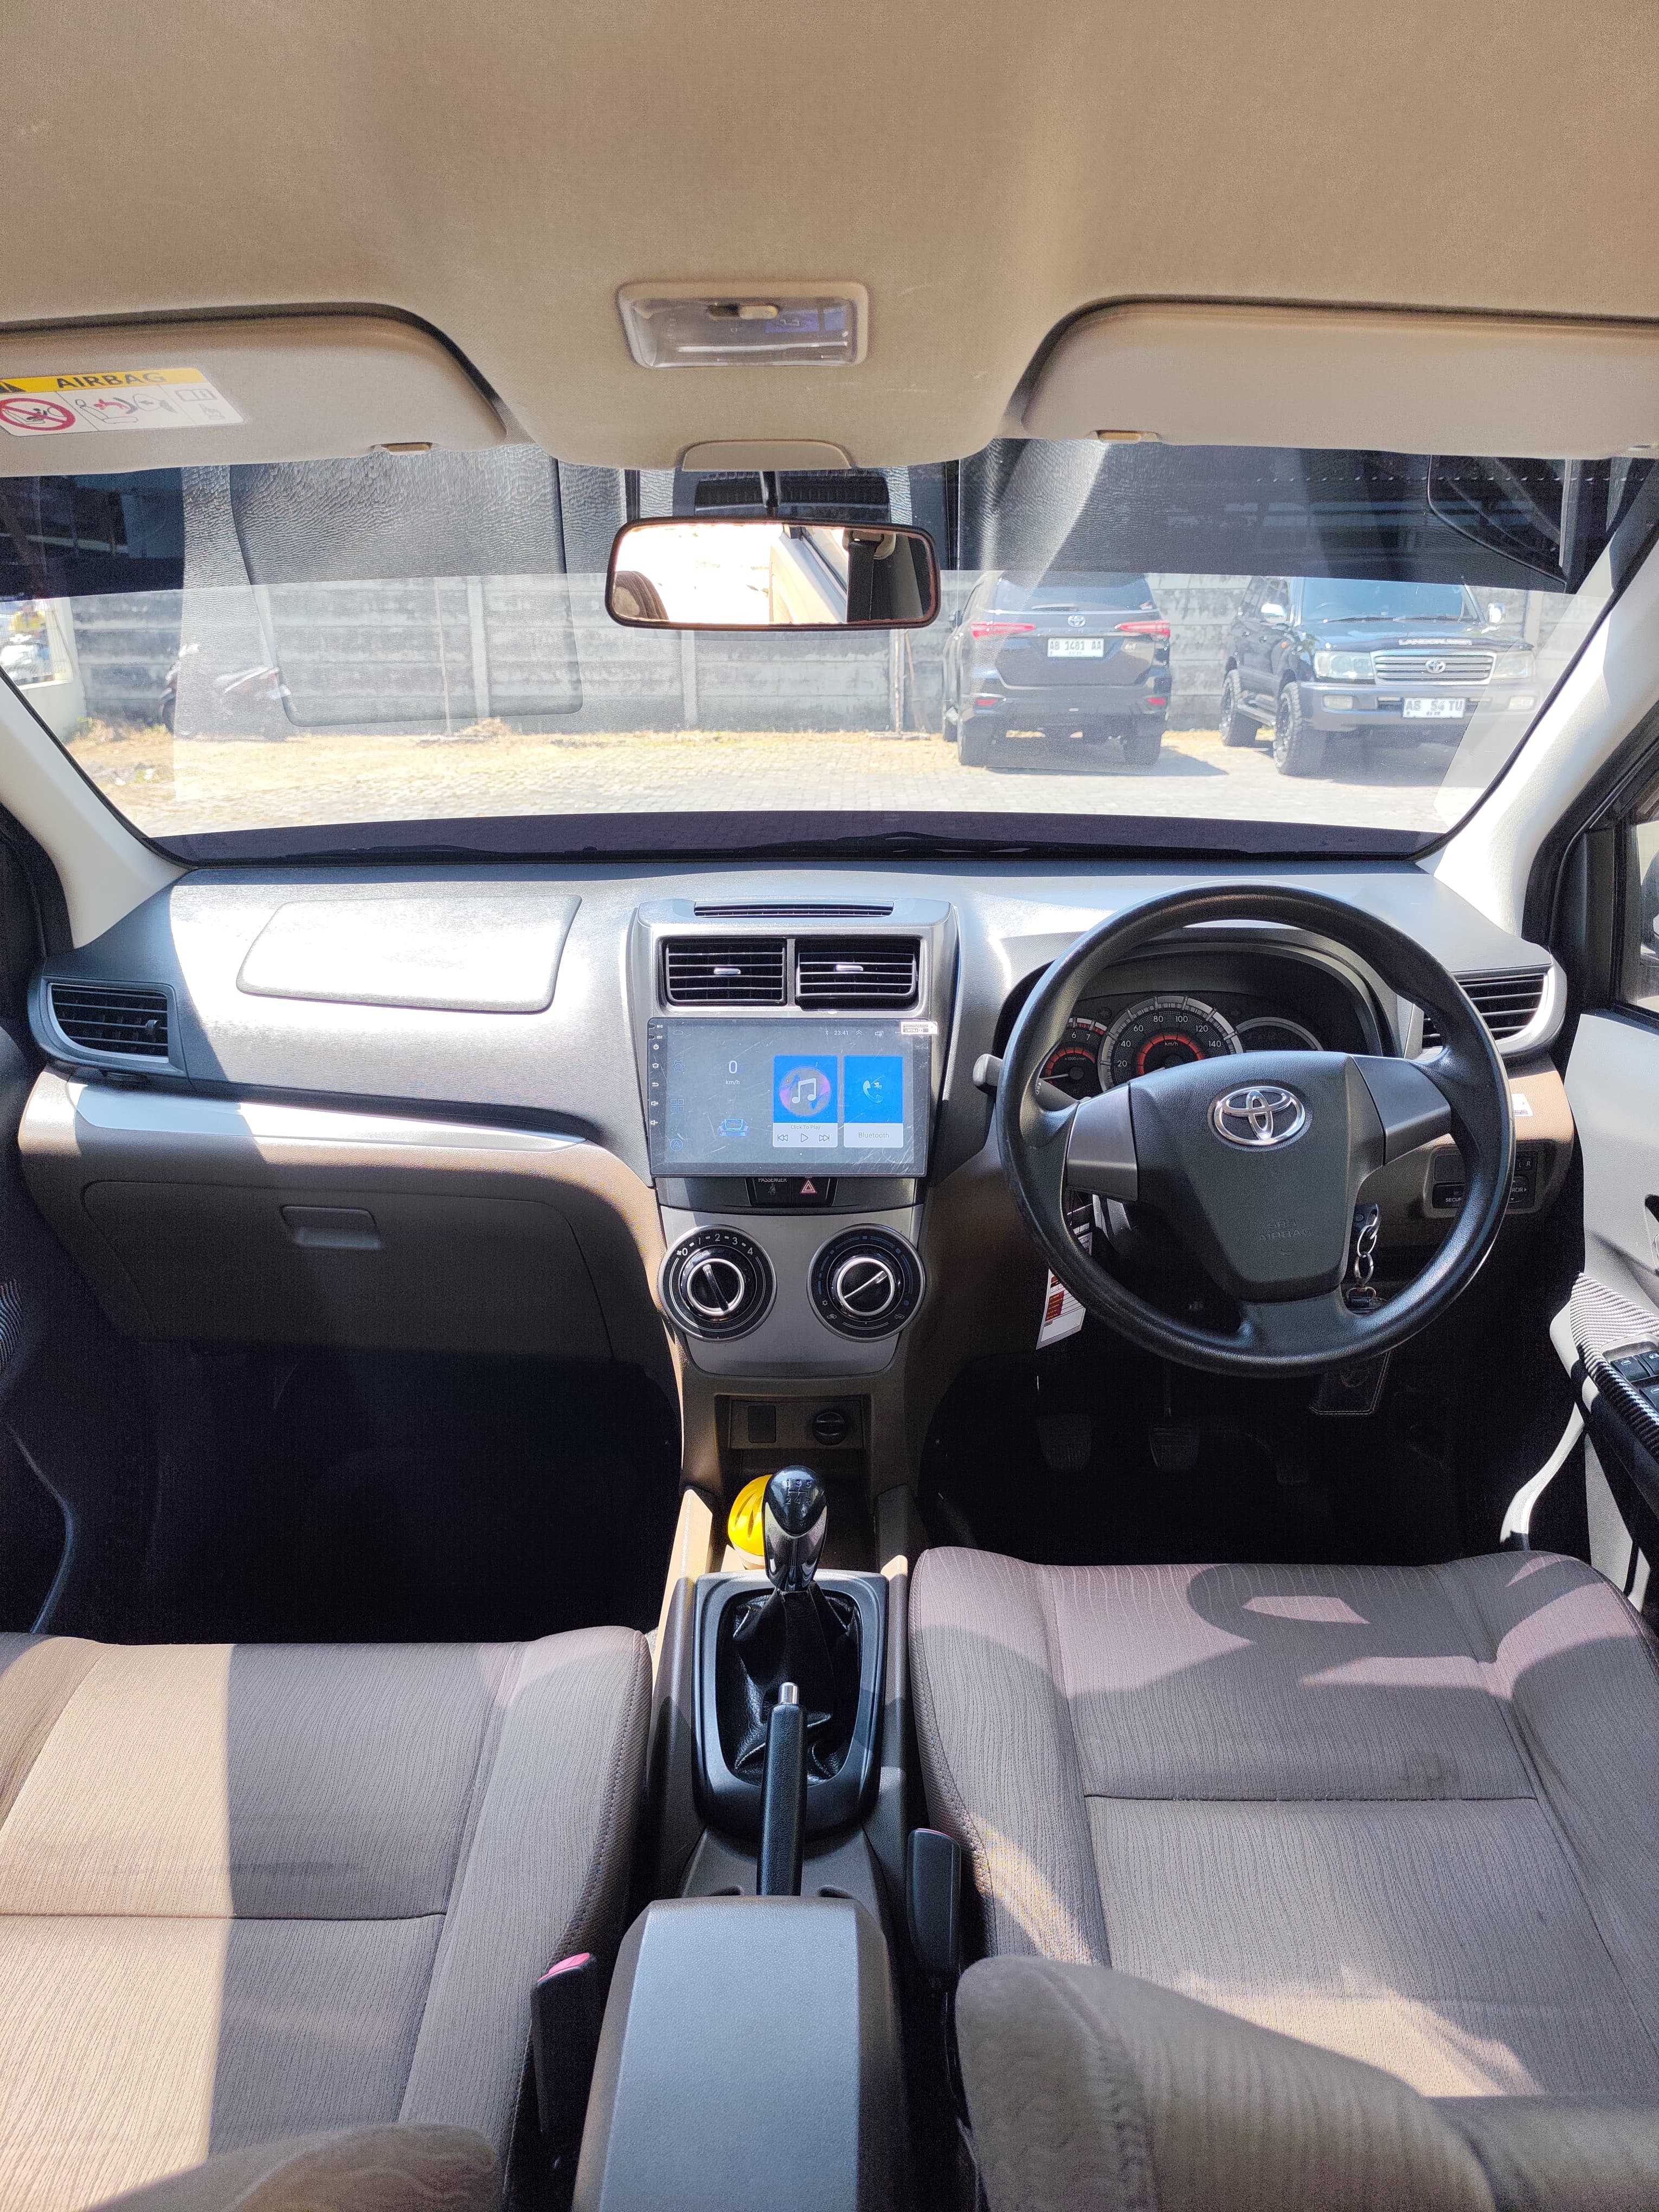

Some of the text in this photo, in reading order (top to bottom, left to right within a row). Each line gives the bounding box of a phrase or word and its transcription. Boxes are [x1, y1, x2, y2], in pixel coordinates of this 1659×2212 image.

[56, 372, 168, 389] AIRBAG
[1050, 641, 1060, 650] AB
[1091, 641, 1102, 650] AA
[1405, 700, 1422, 711] AB
[728, 1060, 738, 1074] 0
[1259, 1227, 1312, 1240] AIRBAG
[681, 1233, 753, 1256] 0 1 2 3 4
[806, 1480, 812, 1488] 5
[785, 1496, 792, 1504] 2
[794, 1496, 801, 1504] 4
